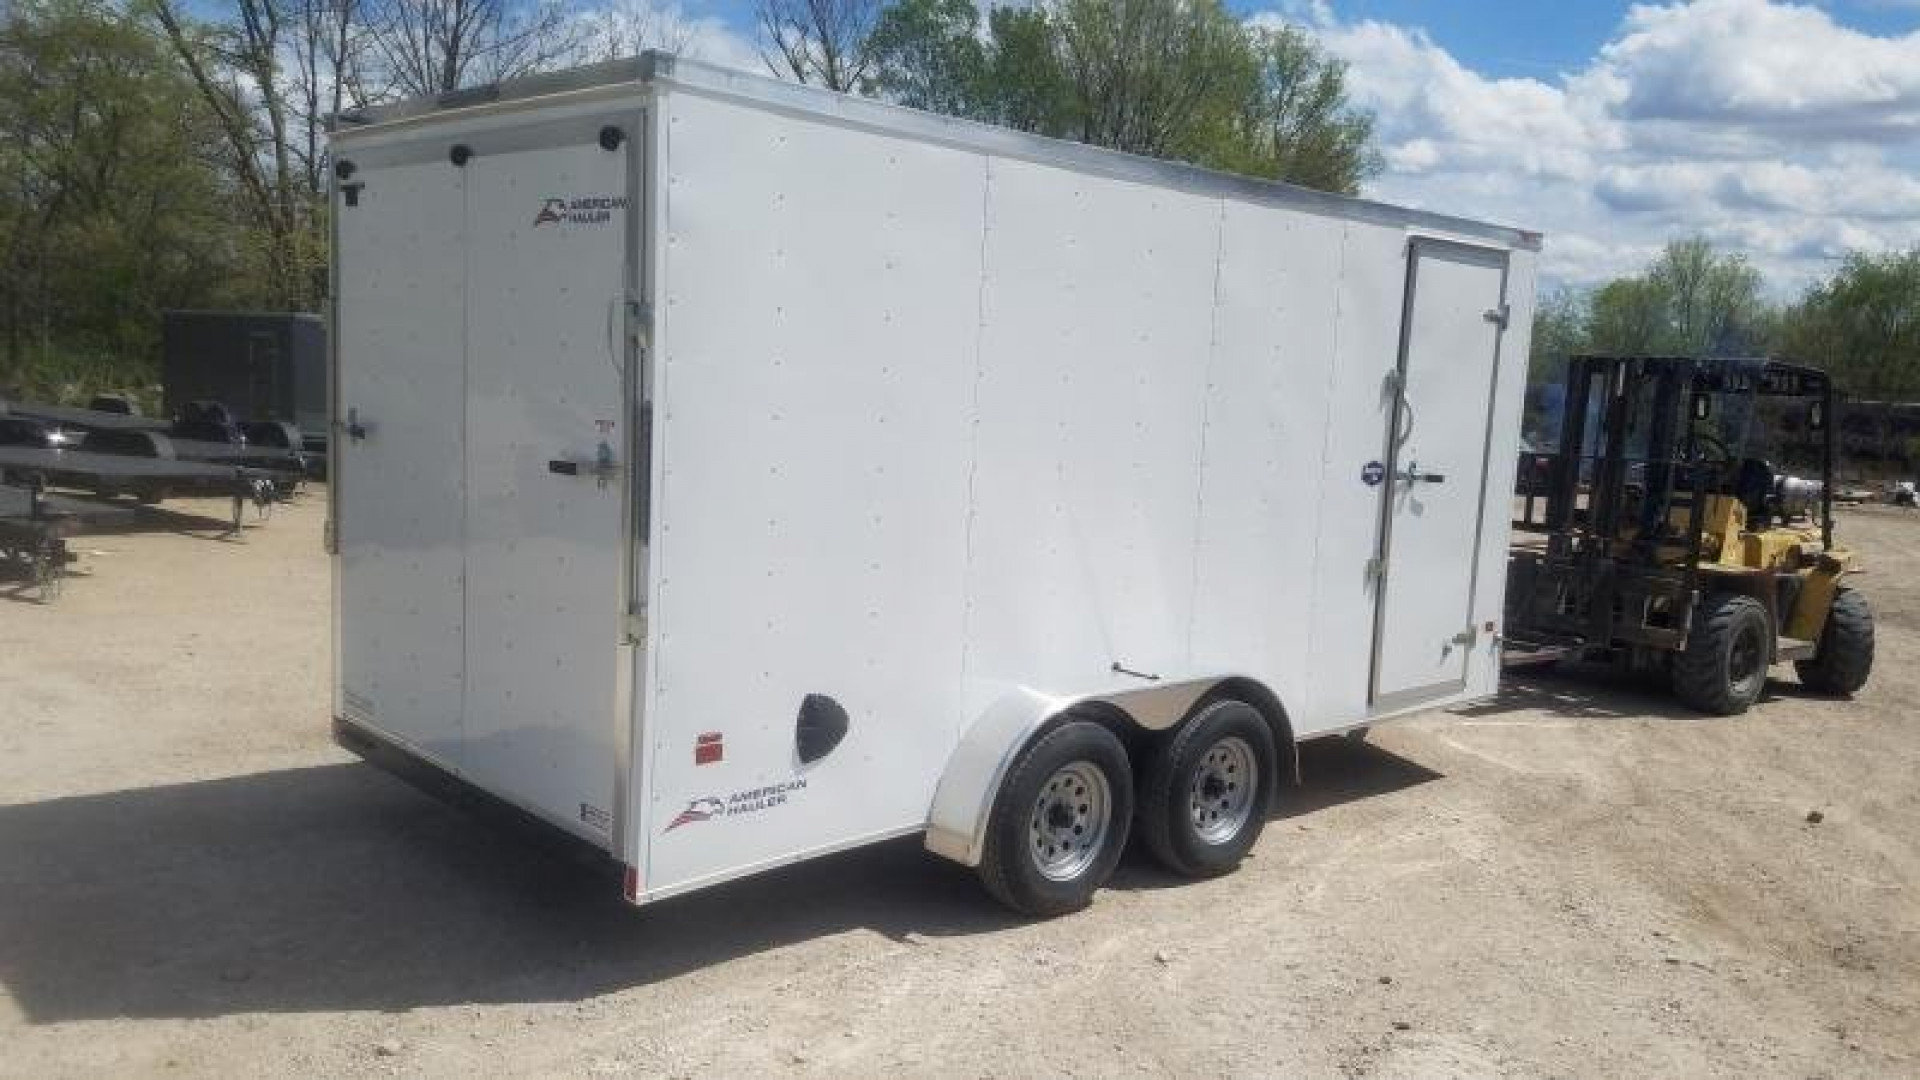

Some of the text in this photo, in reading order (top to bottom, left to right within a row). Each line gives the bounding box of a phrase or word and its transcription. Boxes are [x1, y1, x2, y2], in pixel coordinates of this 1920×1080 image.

[570, 198, 630, 210] AMERICAN
[568, 211, 610, 223] HAULER
[729, 779, 807, 804] AMERICAN
[727, 794, 788, 816] HAULER
